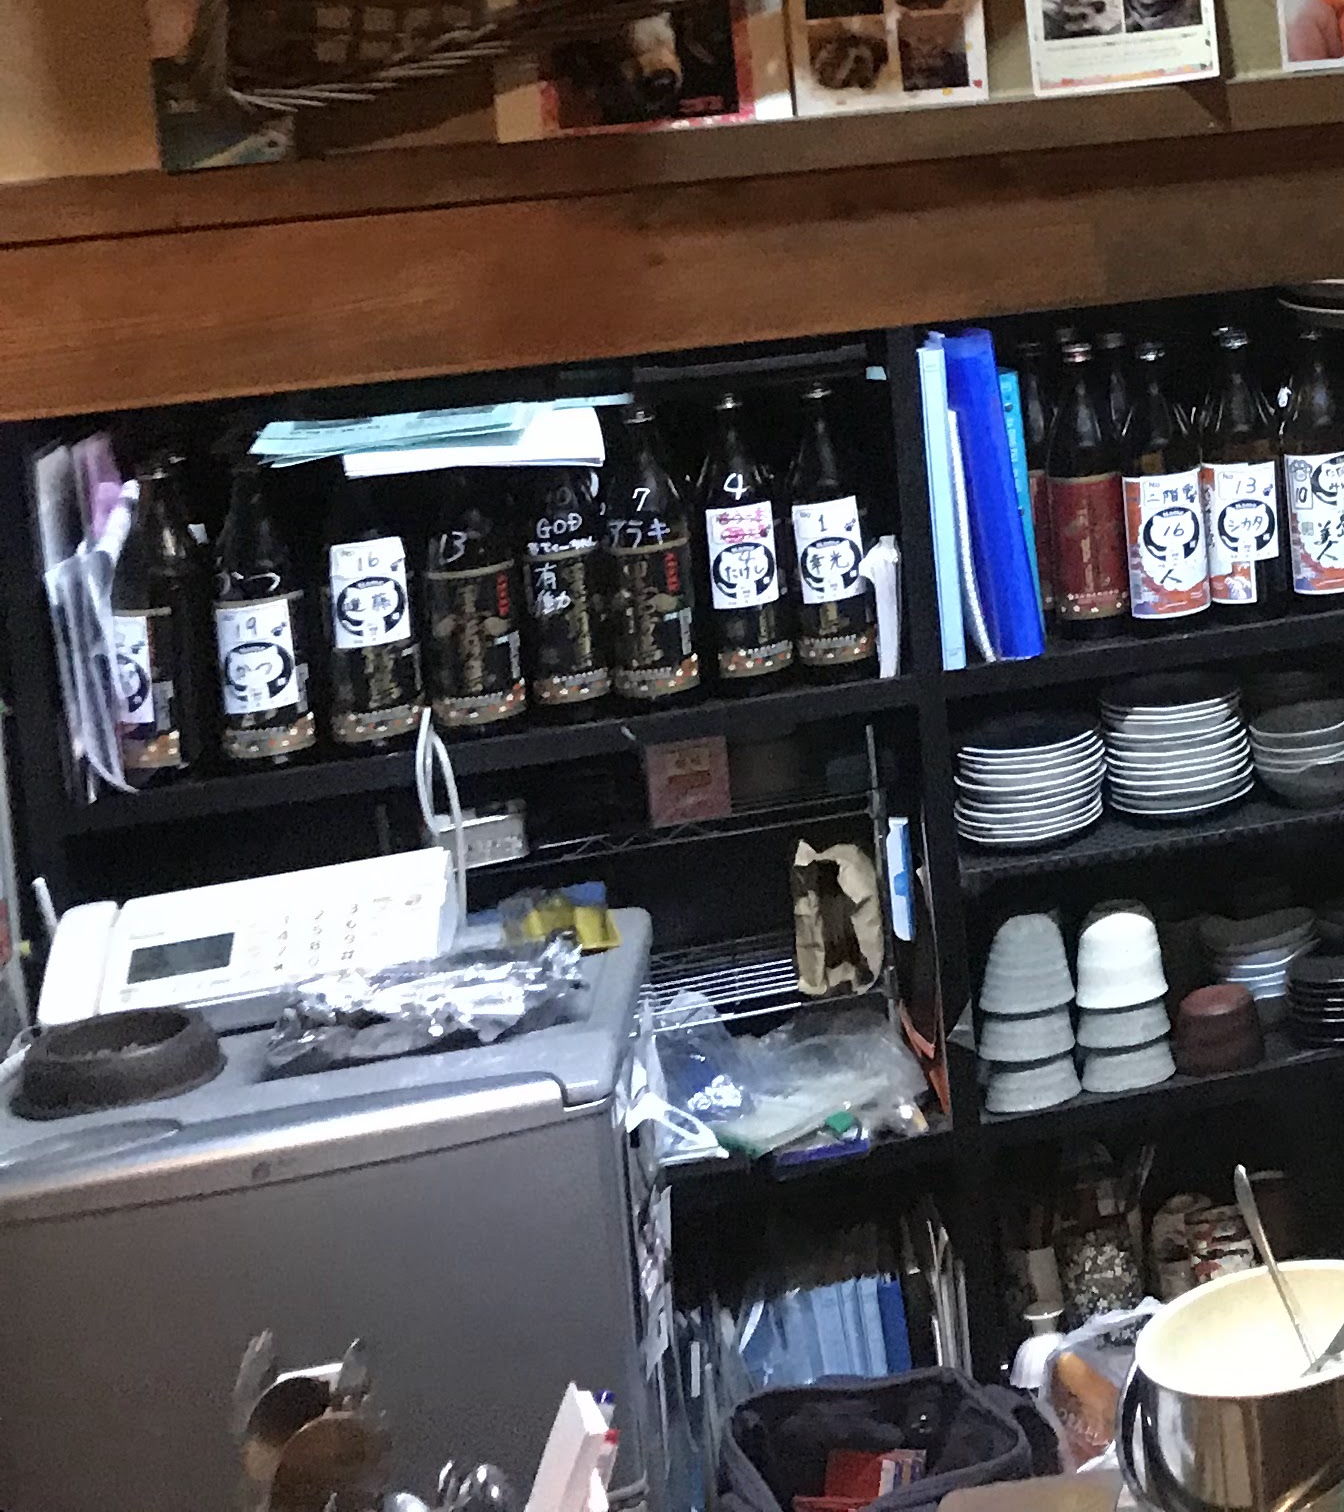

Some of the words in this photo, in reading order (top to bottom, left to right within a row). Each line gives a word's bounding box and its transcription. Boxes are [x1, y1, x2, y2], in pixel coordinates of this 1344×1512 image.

[723, 472, 750, 501] 4
[1235, 477, 1257, 495] 13
[631, 487, 651, 512] 7
[818, 514, 828, 532] 1
[1162, 522, 1185, 537] 16
[357, 554, 380, 571] 16
